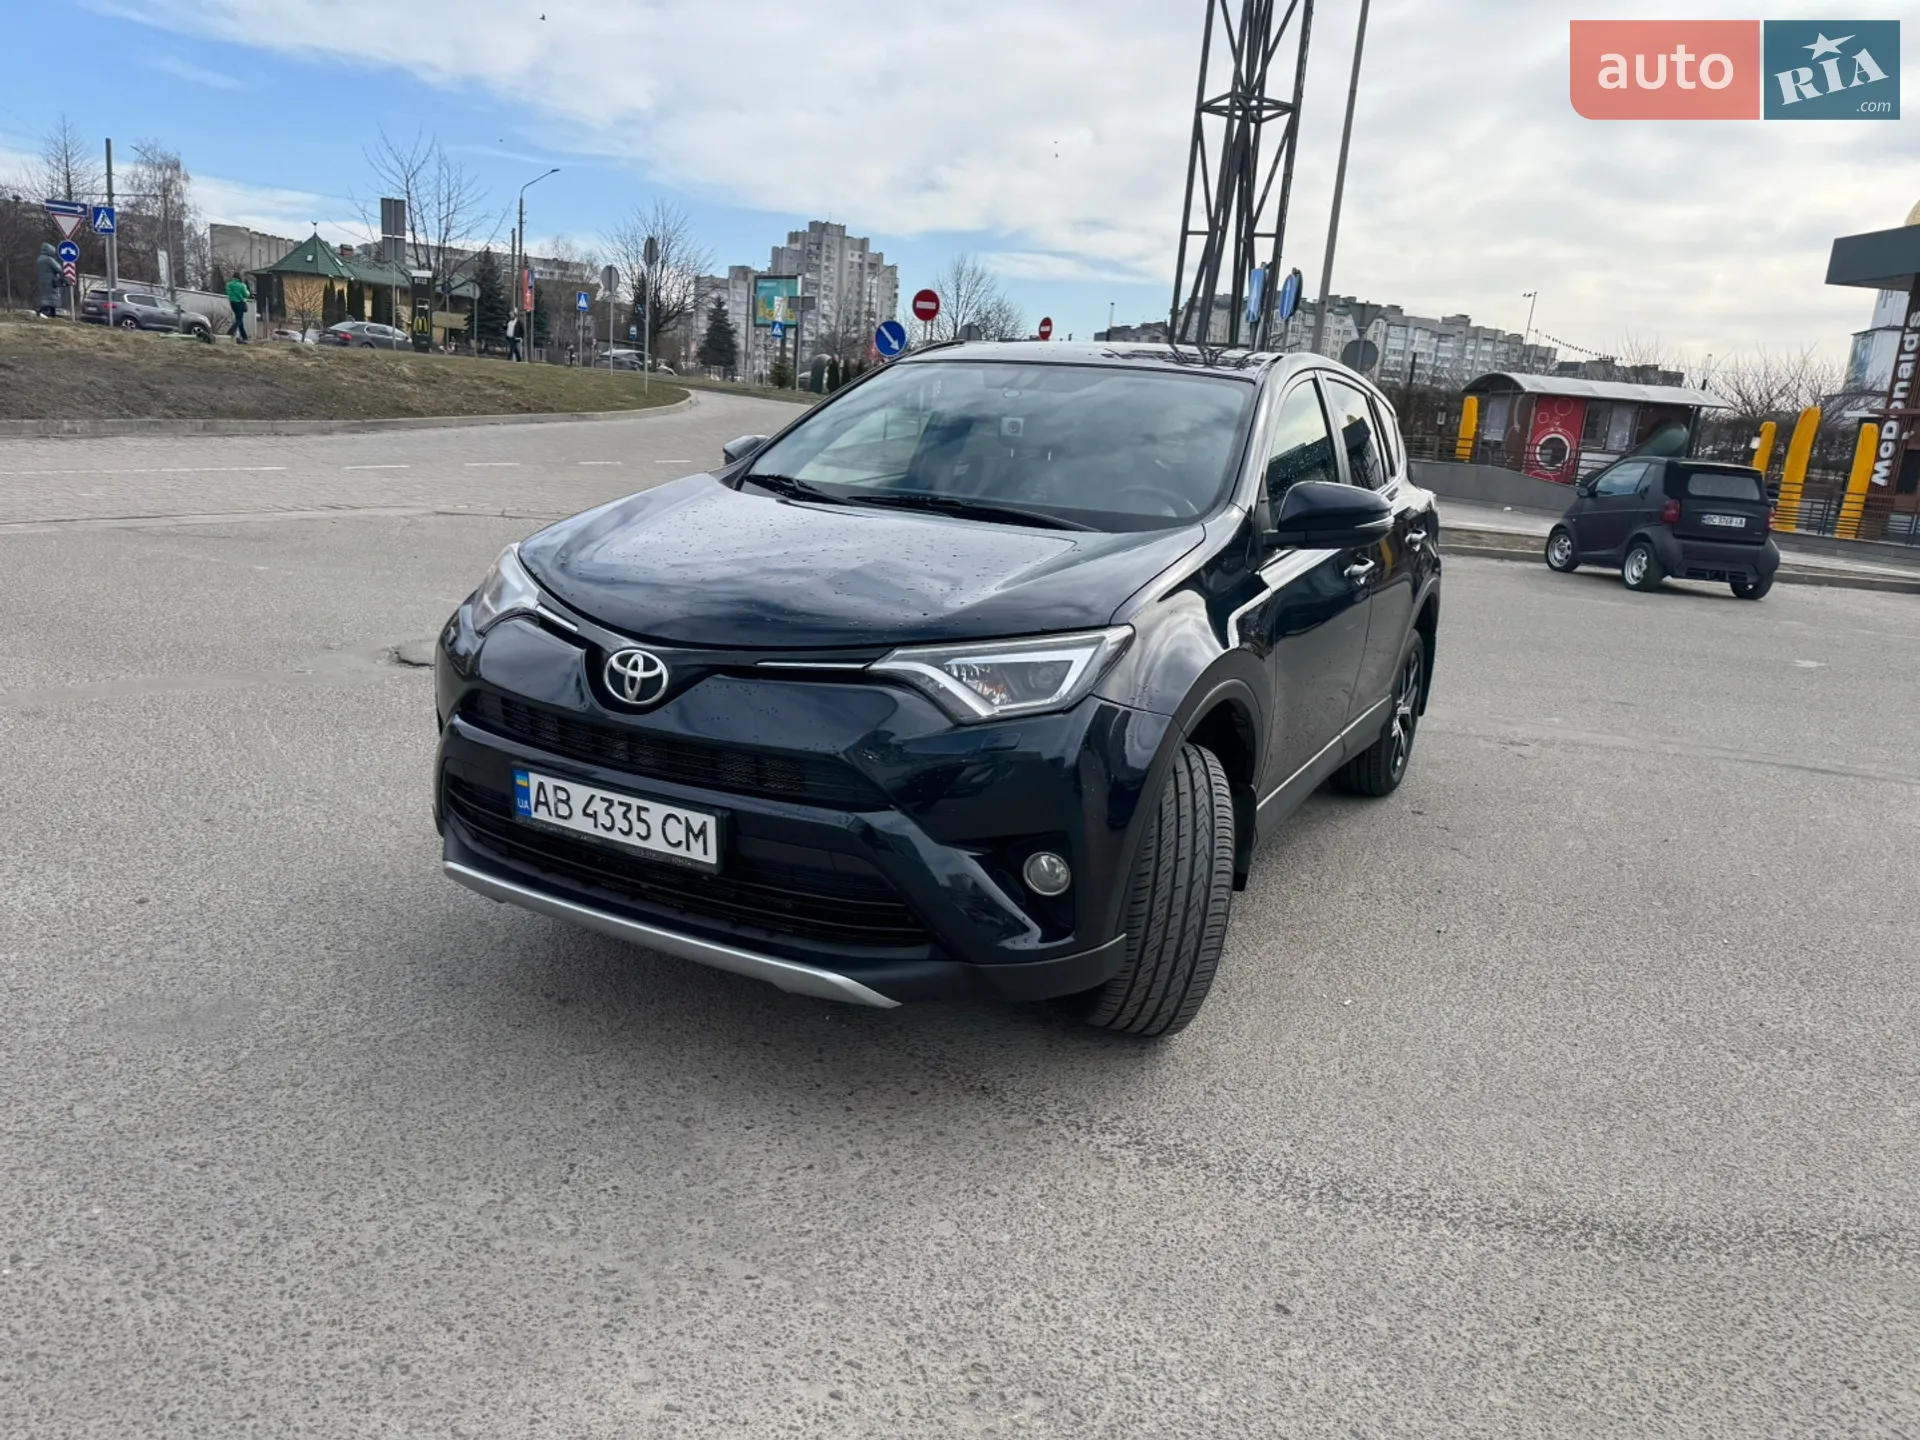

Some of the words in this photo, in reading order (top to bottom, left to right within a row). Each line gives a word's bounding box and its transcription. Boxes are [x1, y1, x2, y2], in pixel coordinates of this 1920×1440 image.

[1871, 310, 1920, 487] McDonald's
[517, 797, 530, 811] UA
[533, 781, 573, 820] AB
[582, 794, 651, 841] 4335
[661, 813, 709, 856] CM
